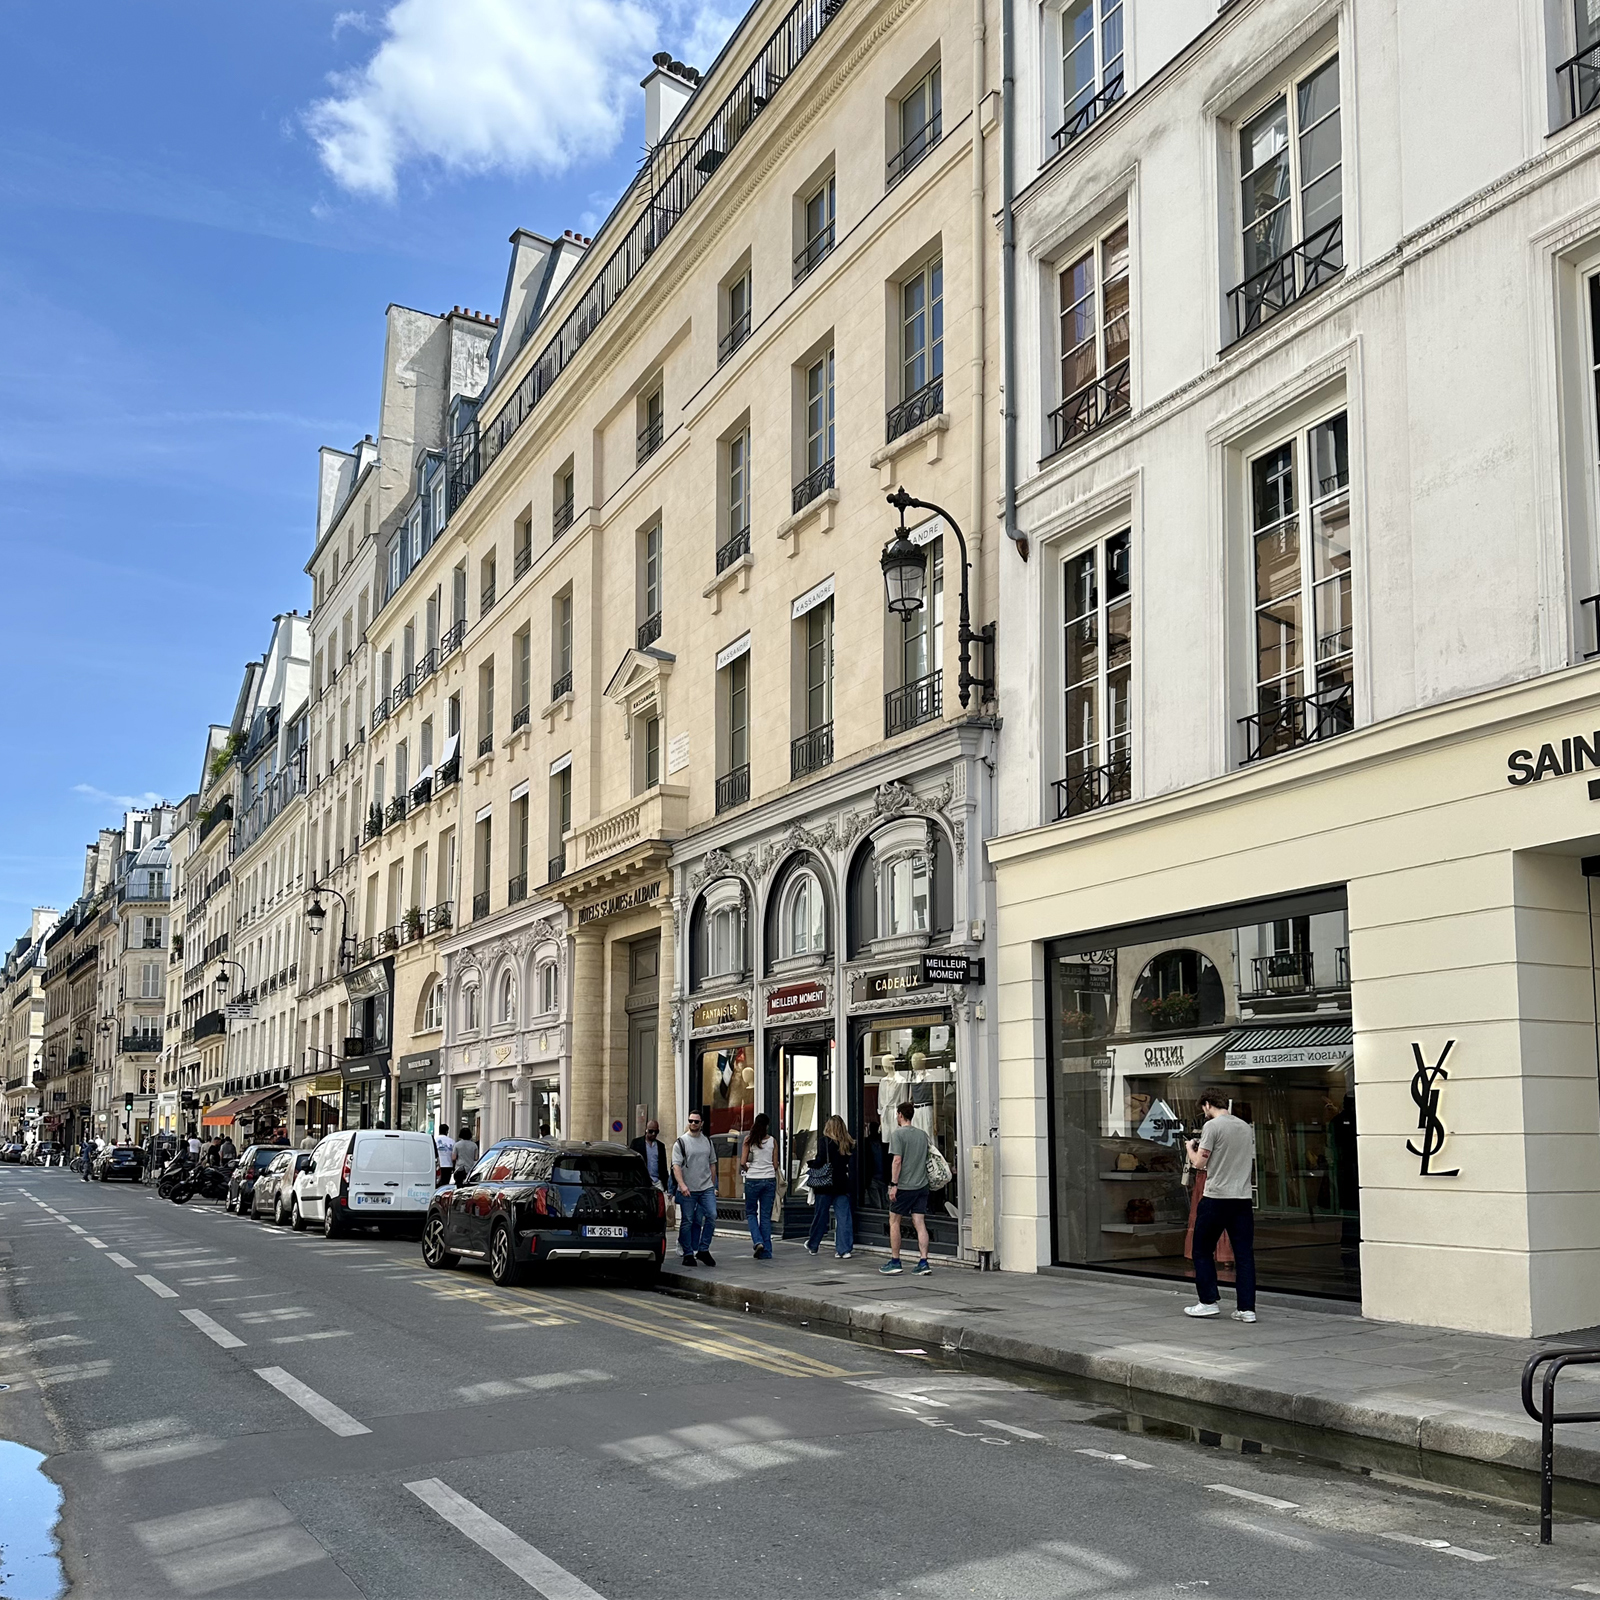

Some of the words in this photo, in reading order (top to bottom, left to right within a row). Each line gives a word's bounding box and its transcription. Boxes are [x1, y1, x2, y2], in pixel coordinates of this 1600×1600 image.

[796, 584, 831, 612] KASSANDRE
[1507, 729, 1600, 786] SAIN
[633, 880, 661, 906] ALBANY
[925, 958, 967, 970] MEILLEUR
[875, 974, 919, 992] CADEAUX
[929, 969, 965, 980] MOMENT
[771, 995, 799, 1009] MEILLEUR
[799, 990, 824, 1004] MOMENT
[702, 1004, 738, 1020] FANTAISIES
